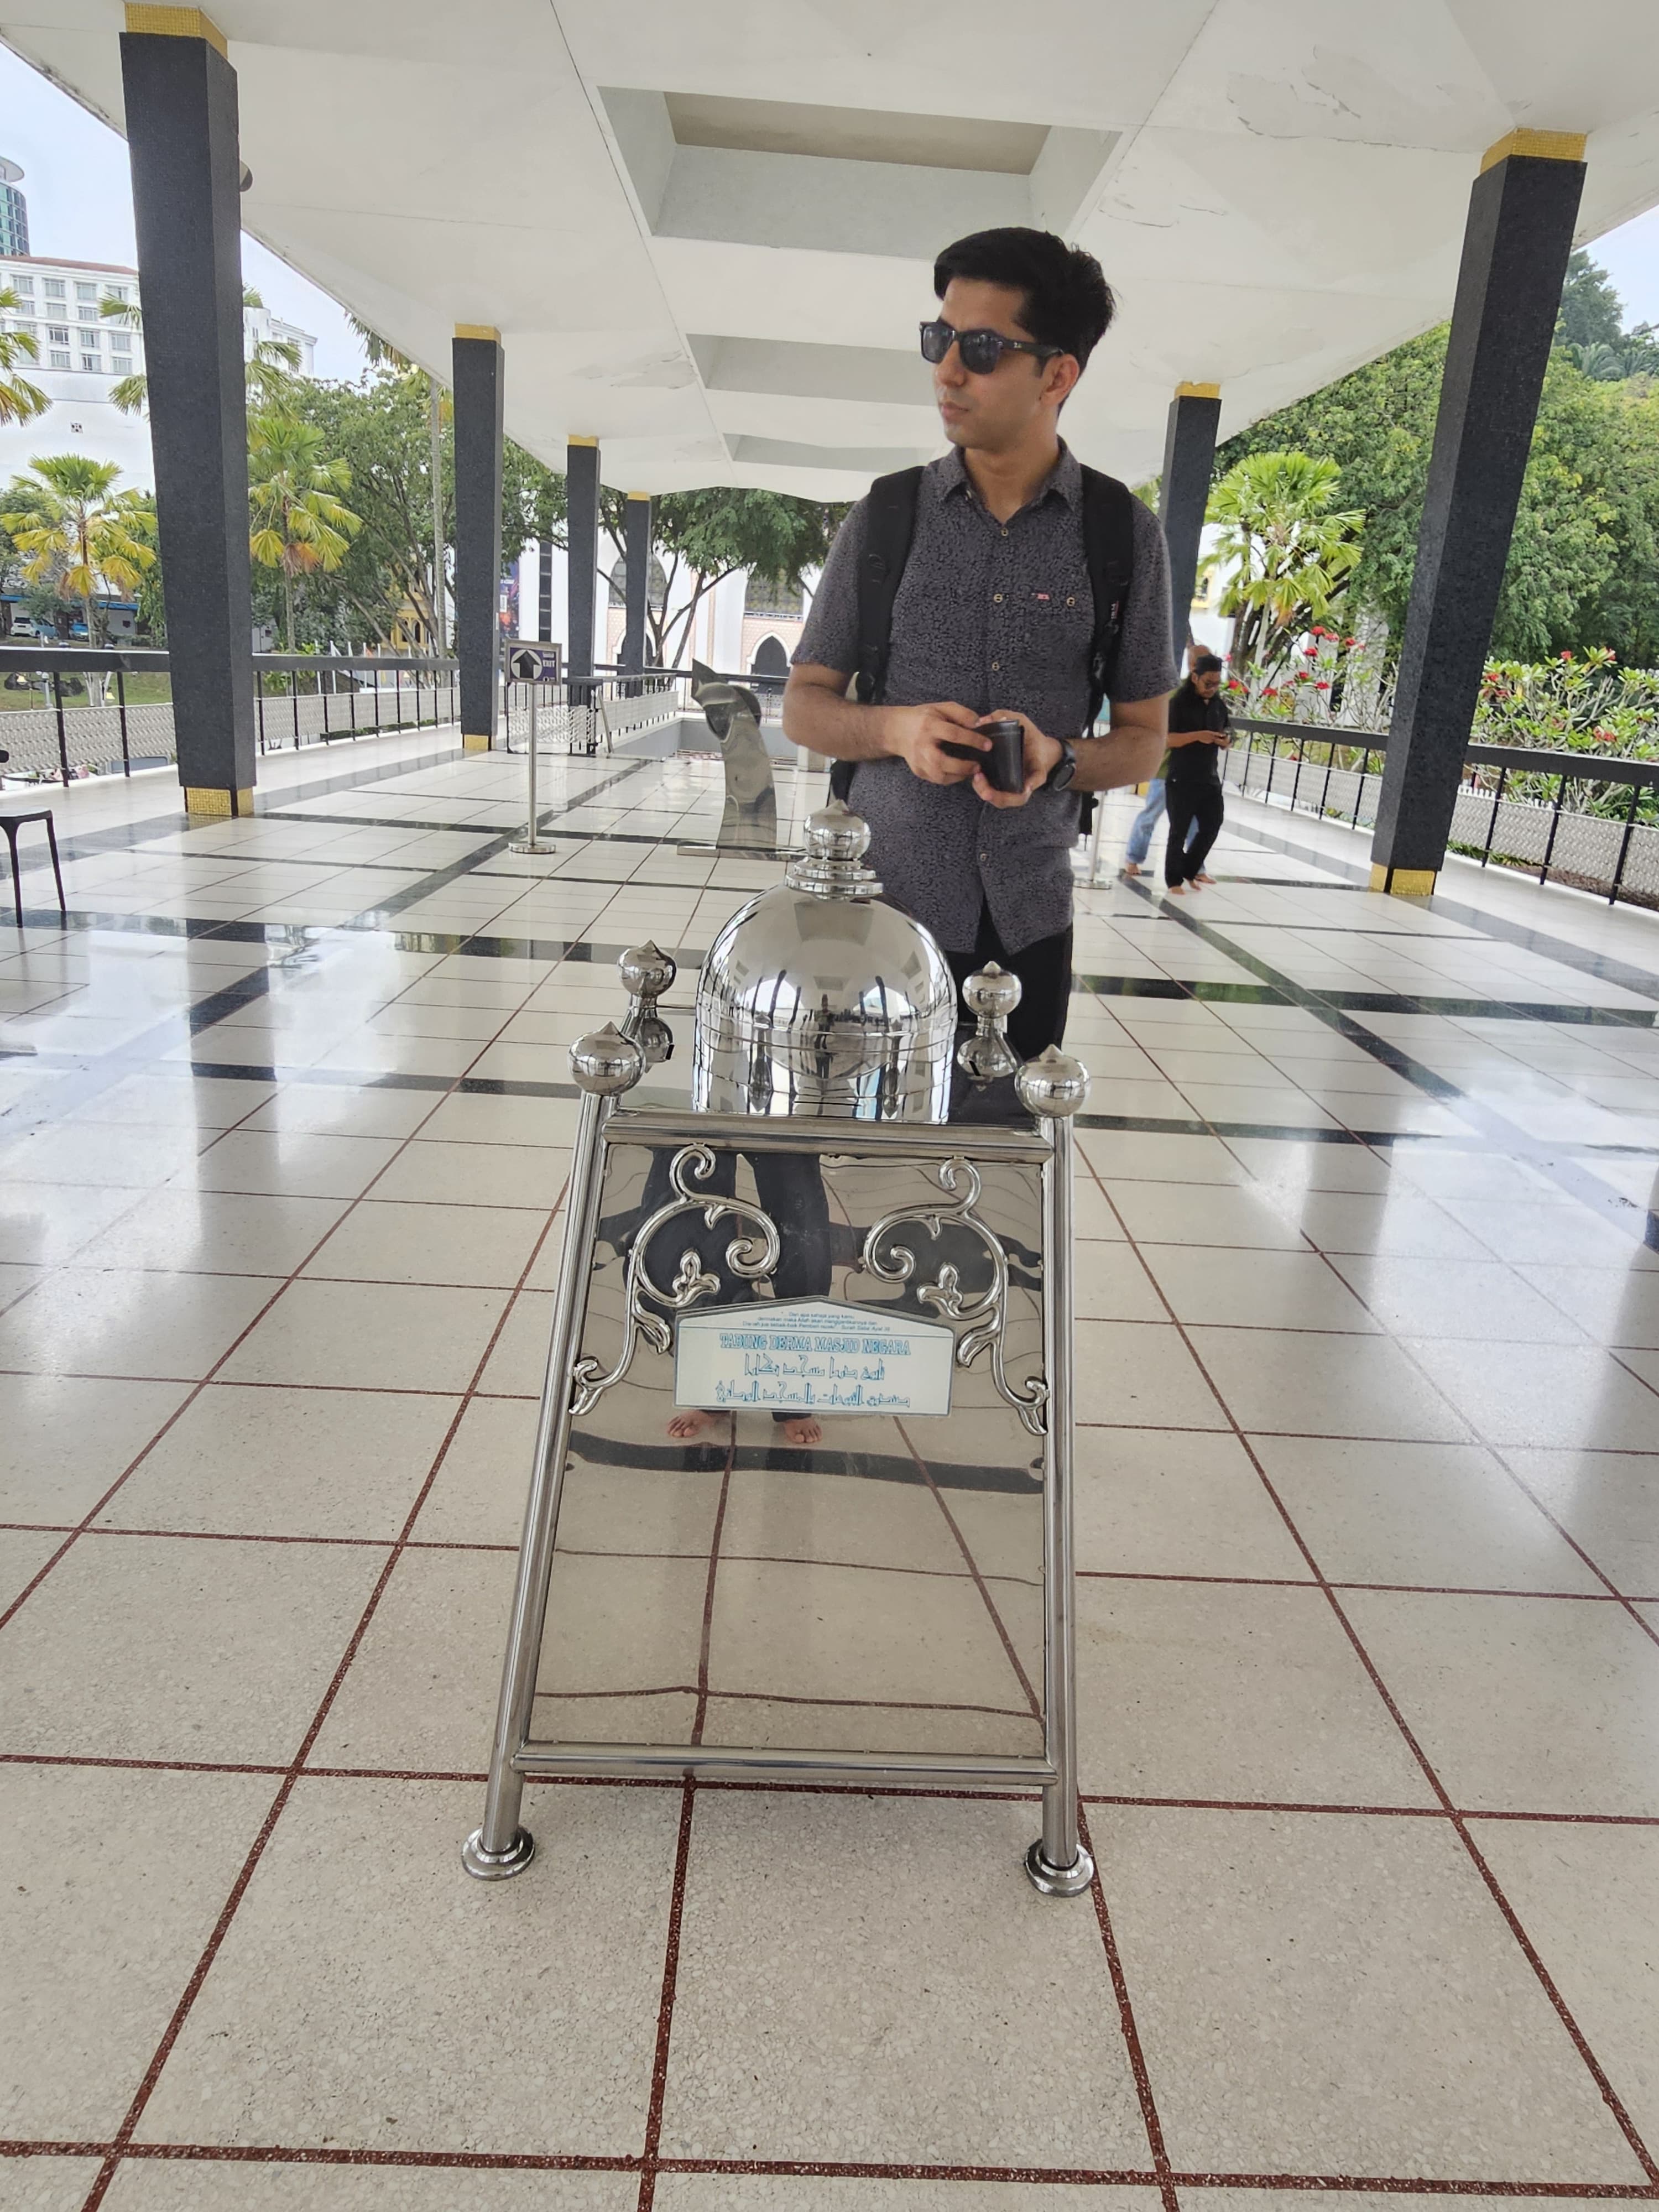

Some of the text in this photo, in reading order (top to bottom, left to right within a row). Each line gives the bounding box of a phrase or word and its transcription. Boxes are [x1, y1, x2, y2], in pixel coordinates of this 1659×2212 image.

[720, 1333, 911, 1355] TABUNG DERMA MASJID NEGARA
